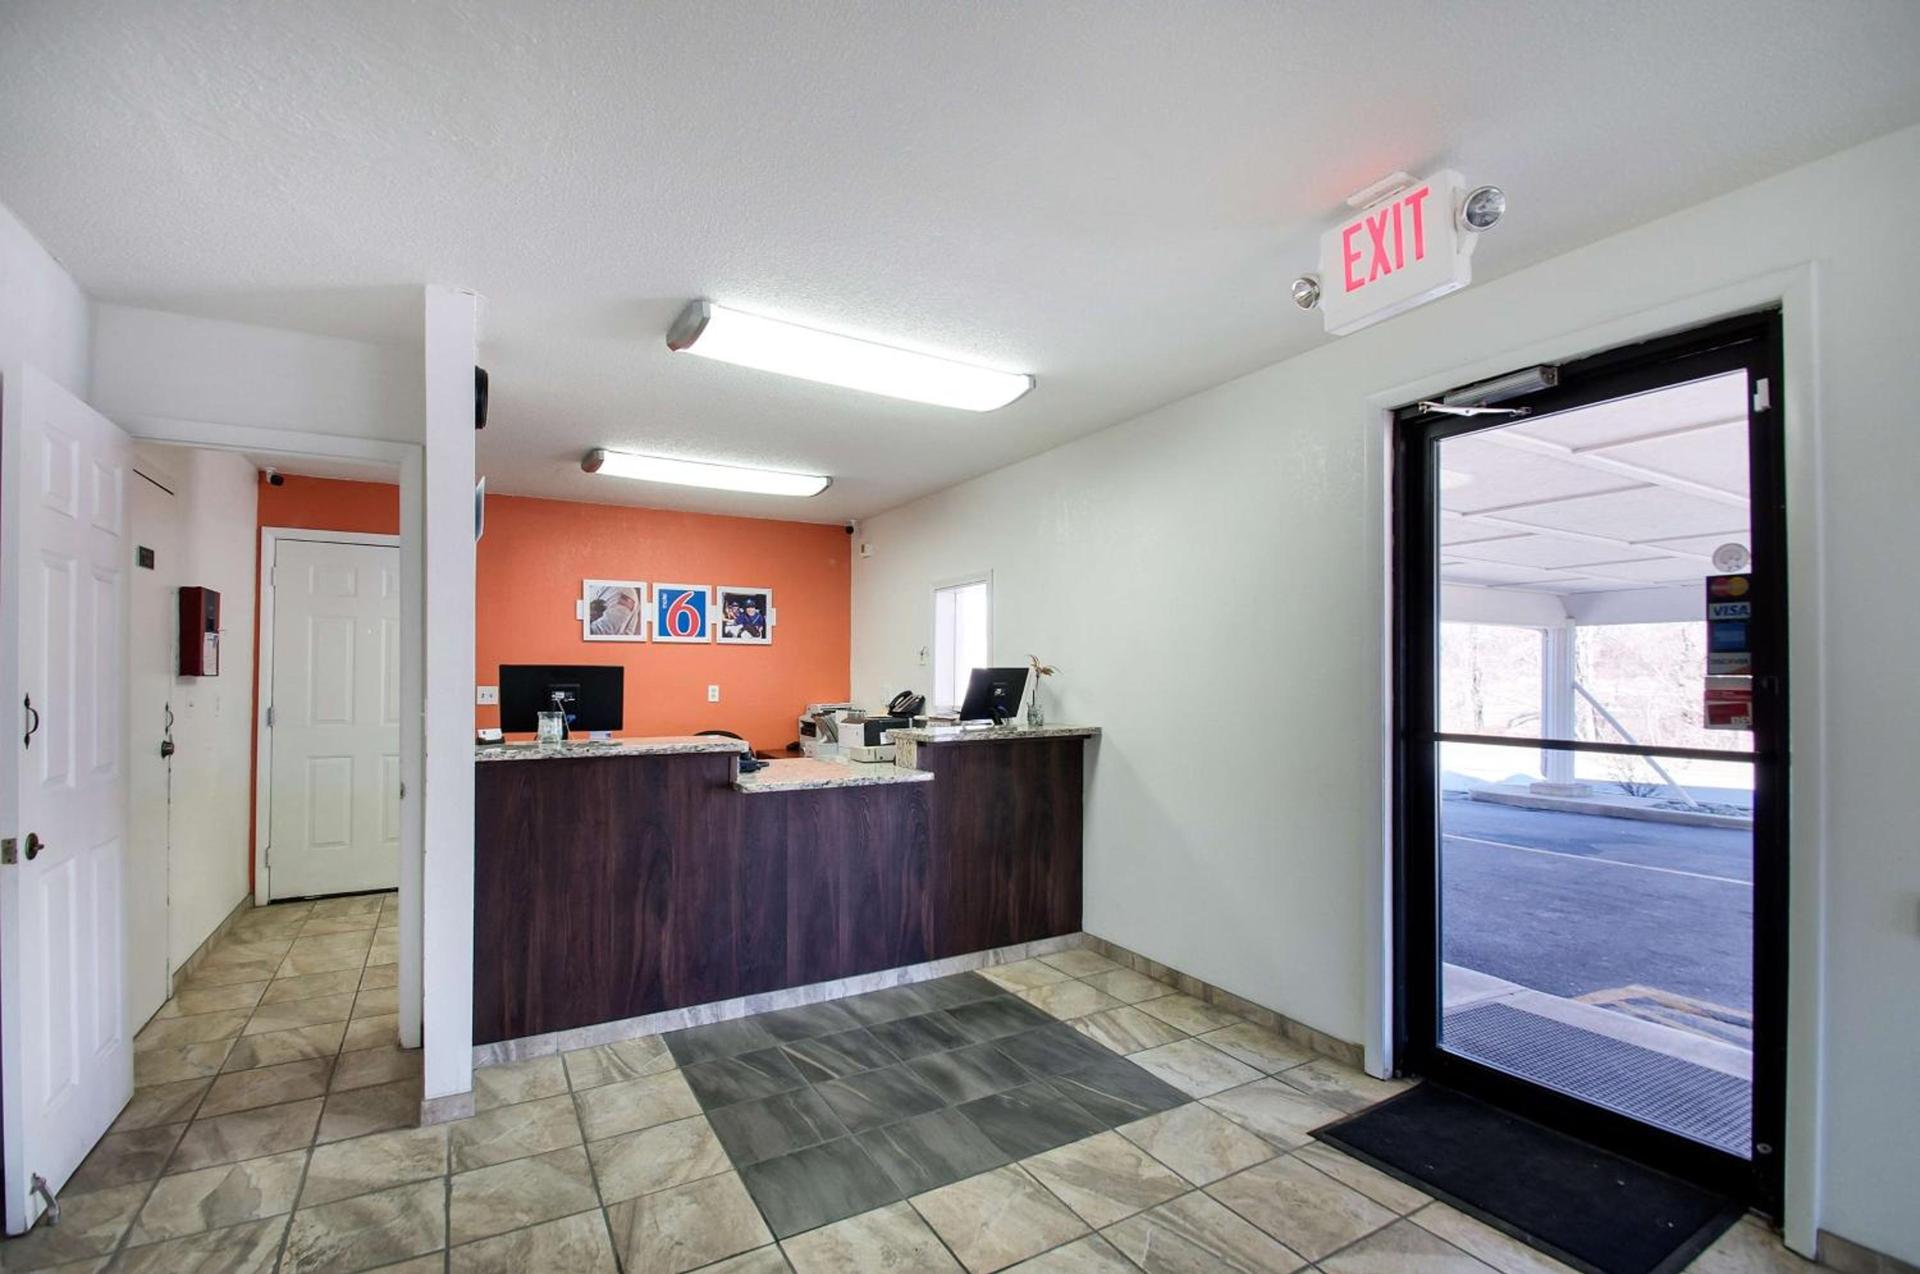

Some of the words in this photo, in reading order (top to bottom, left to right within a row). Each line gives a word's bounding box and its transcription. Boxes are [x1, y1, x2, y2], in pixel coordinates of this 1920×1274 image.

[1343, 186, 1429, 292] EXIT
[666, 591, 701, 637] 6
[1713, 605, 1750, 617] VISA
